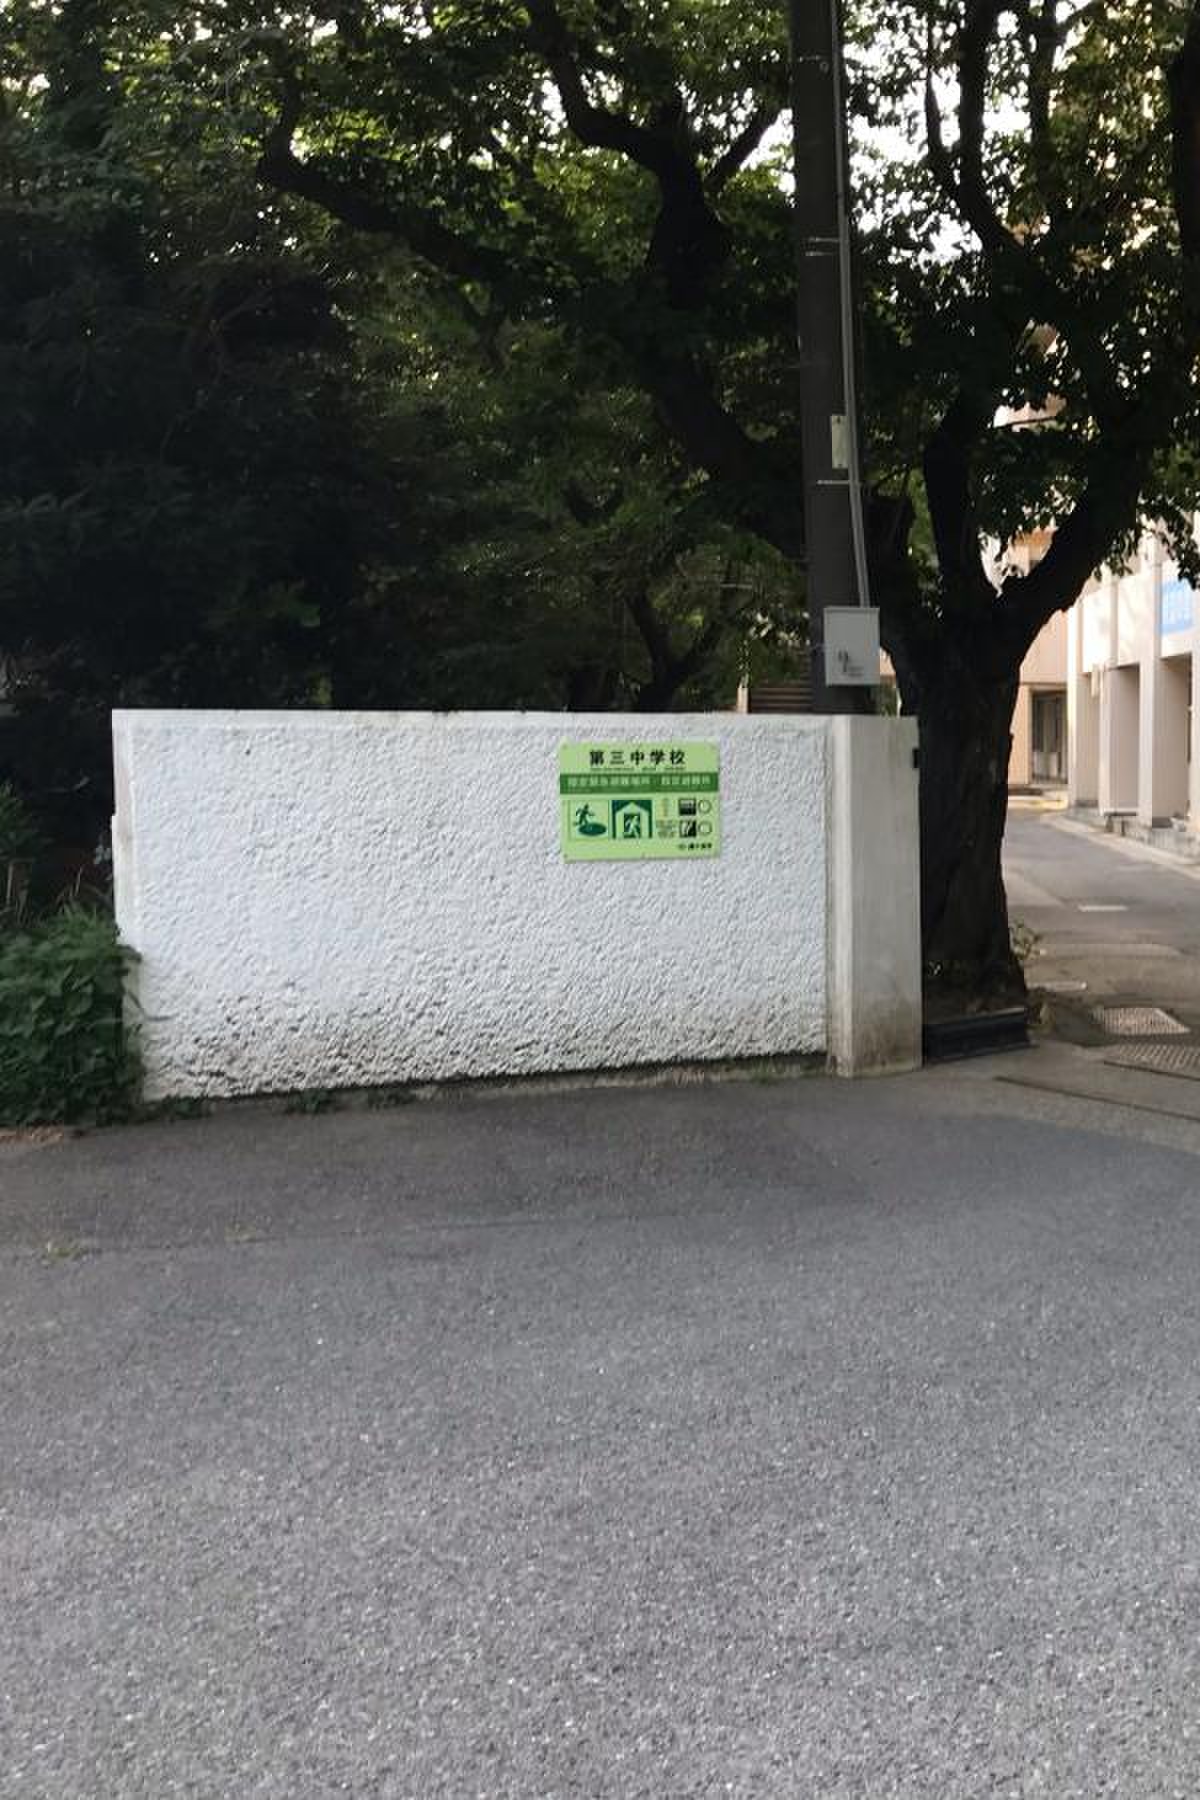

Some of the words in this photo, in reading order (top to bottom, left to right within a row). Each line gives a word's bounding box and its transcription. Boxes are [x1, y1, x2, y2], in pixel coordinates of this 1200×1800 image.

[589, 749, 686, 766] 第三中学校
